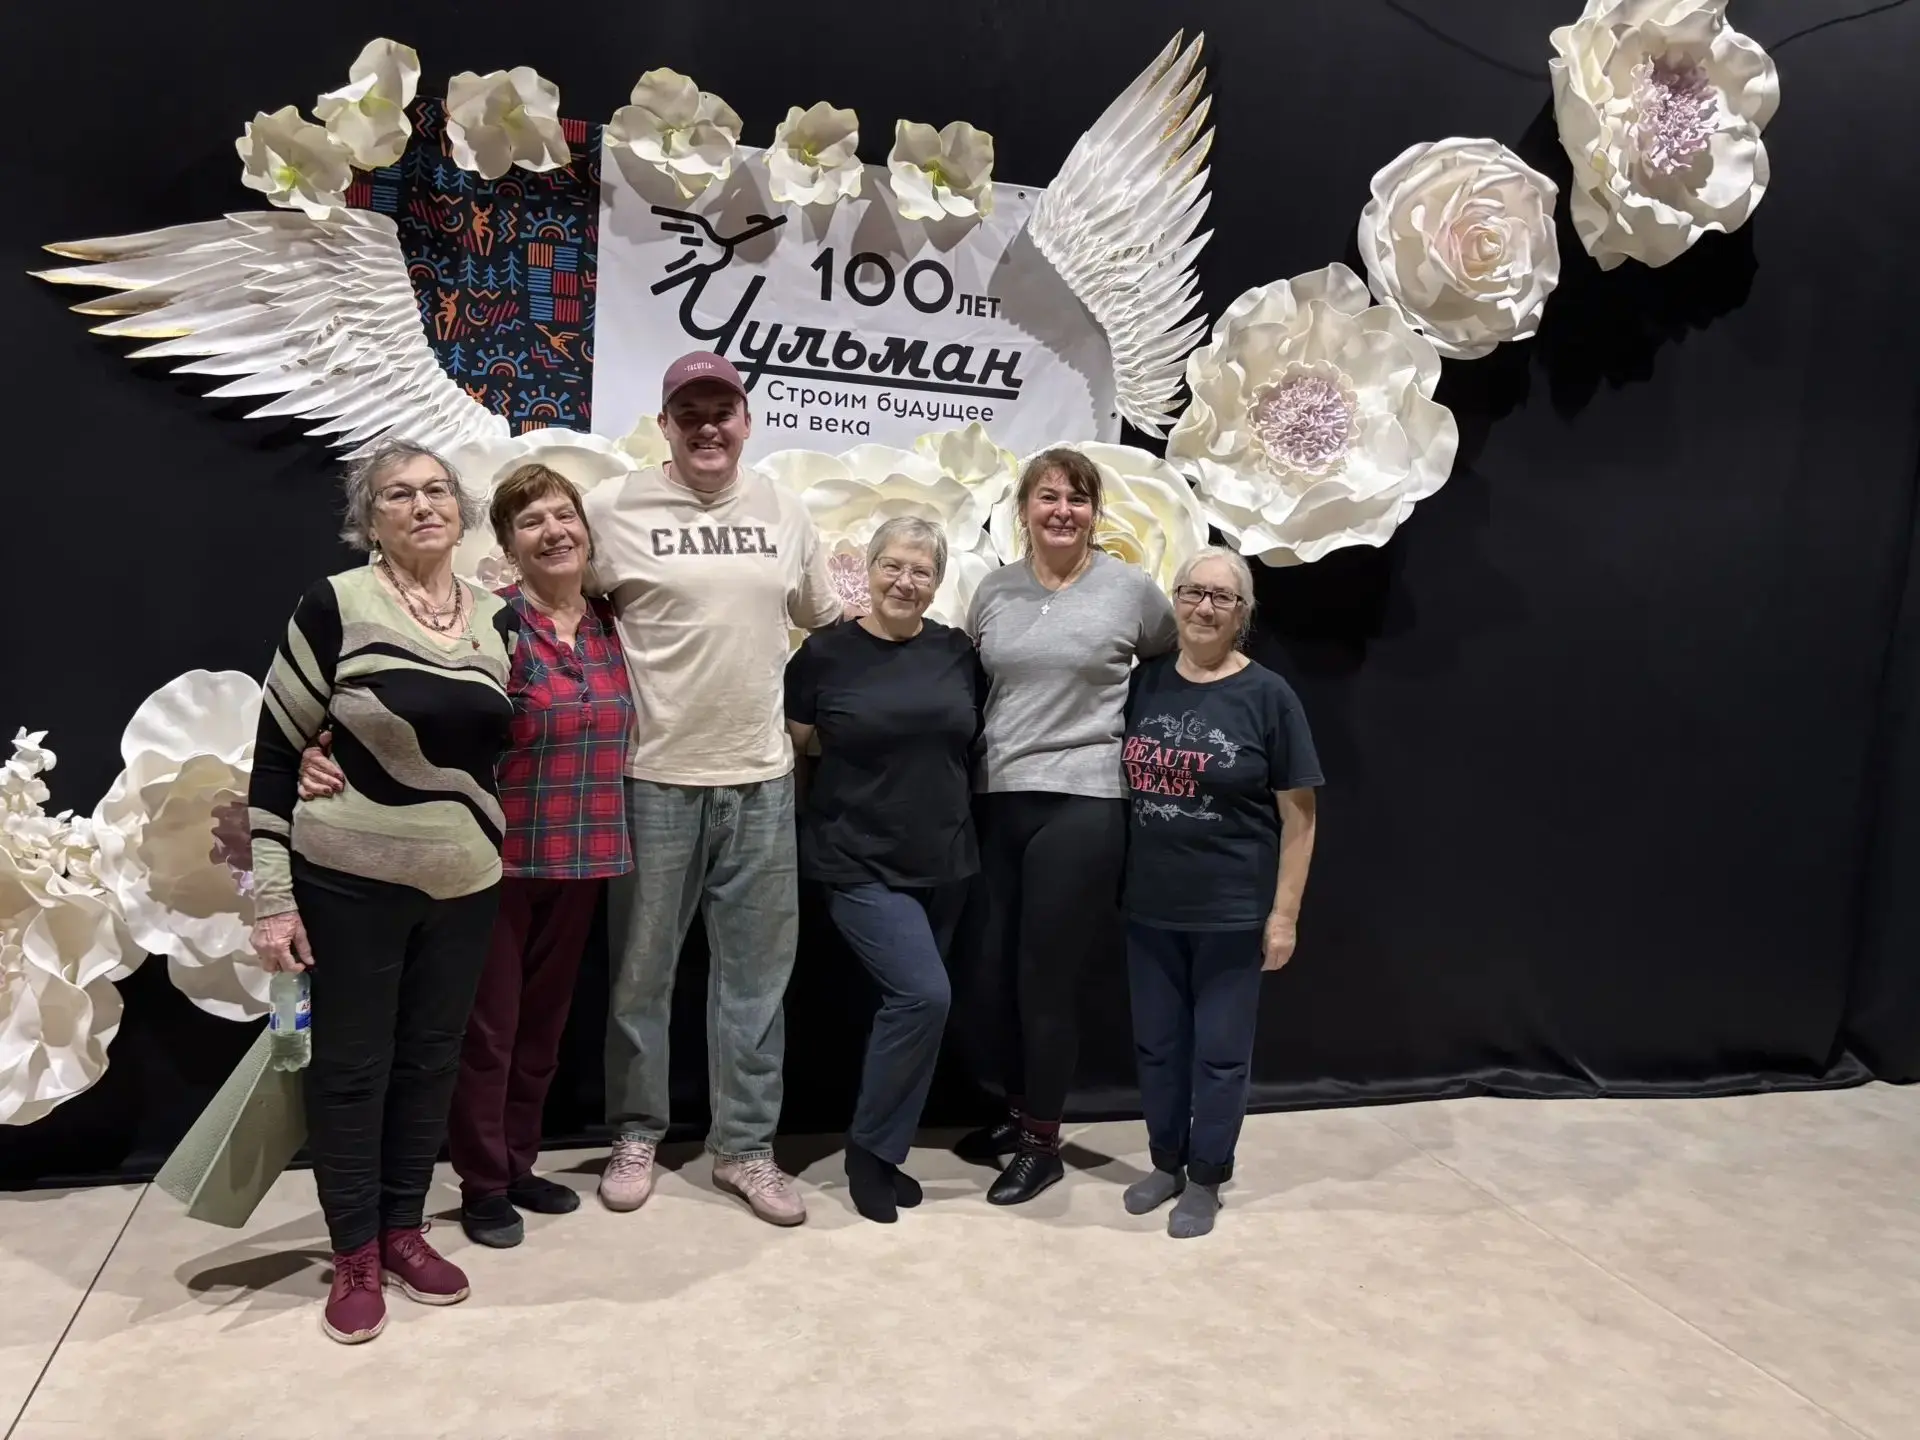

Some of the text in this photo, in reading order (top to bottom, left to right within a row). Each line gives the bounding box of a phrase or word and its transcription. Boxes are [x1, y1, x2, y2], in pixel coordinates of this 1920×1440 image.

[811, 247, 1001, 318] 100 ЛЕТ
[679, 263, 1023, 394] Чульман
[767, 380, 994, 422] Строим будущее
[766, 411, 870, 436] на века
[651, 526, 778, 556] CAMEL
[1121, 736, 1214, 772] BEAUTY
[1143, 765, 1193, 779] AND THE
[1125, 761, 1200, 798] BEAST
